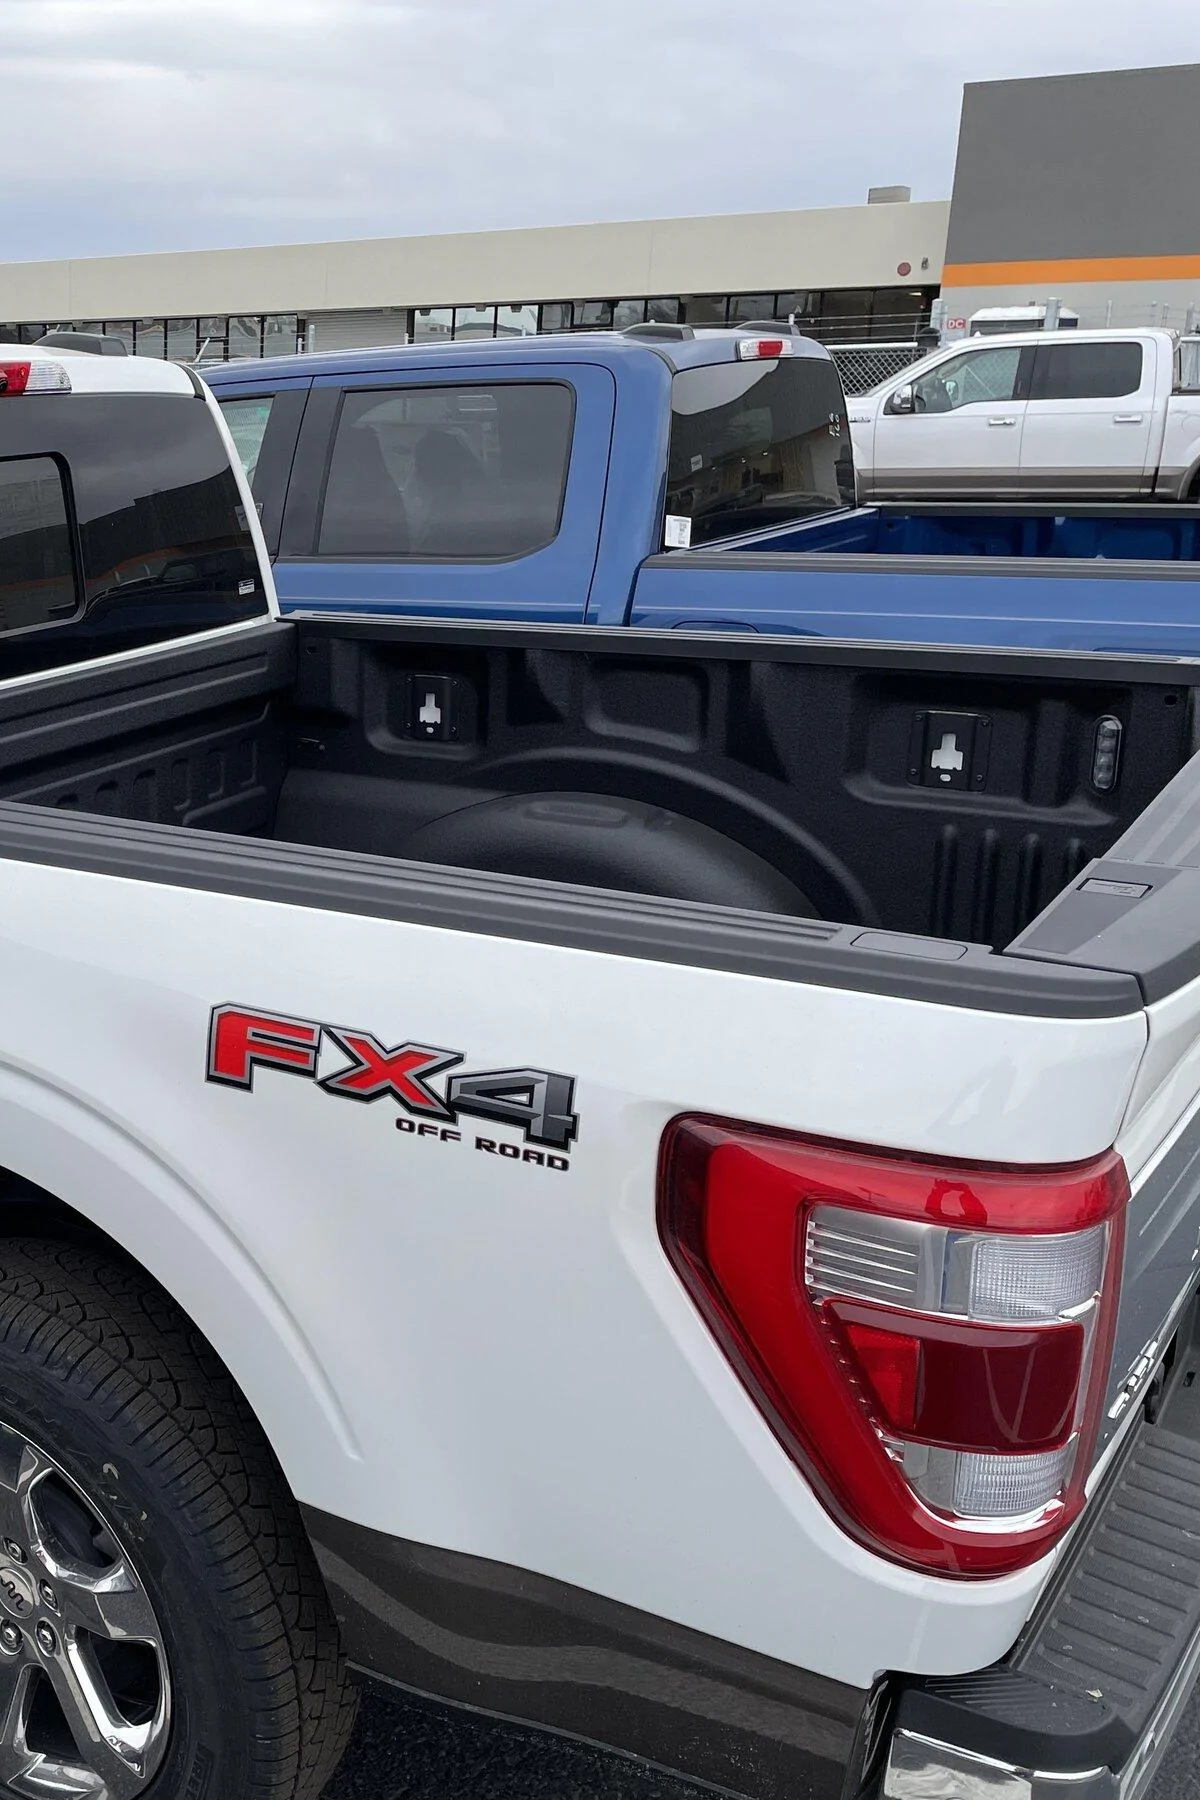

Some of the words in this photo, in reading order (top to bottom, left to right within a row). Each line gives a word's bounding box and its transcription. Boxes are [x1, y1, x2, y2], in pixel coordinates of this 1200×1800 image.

[205, 1000, 580, 1153] FX4
[395, 1116, 462, 1143] OFF
[475, 1134, 570, 1173] ROAD
